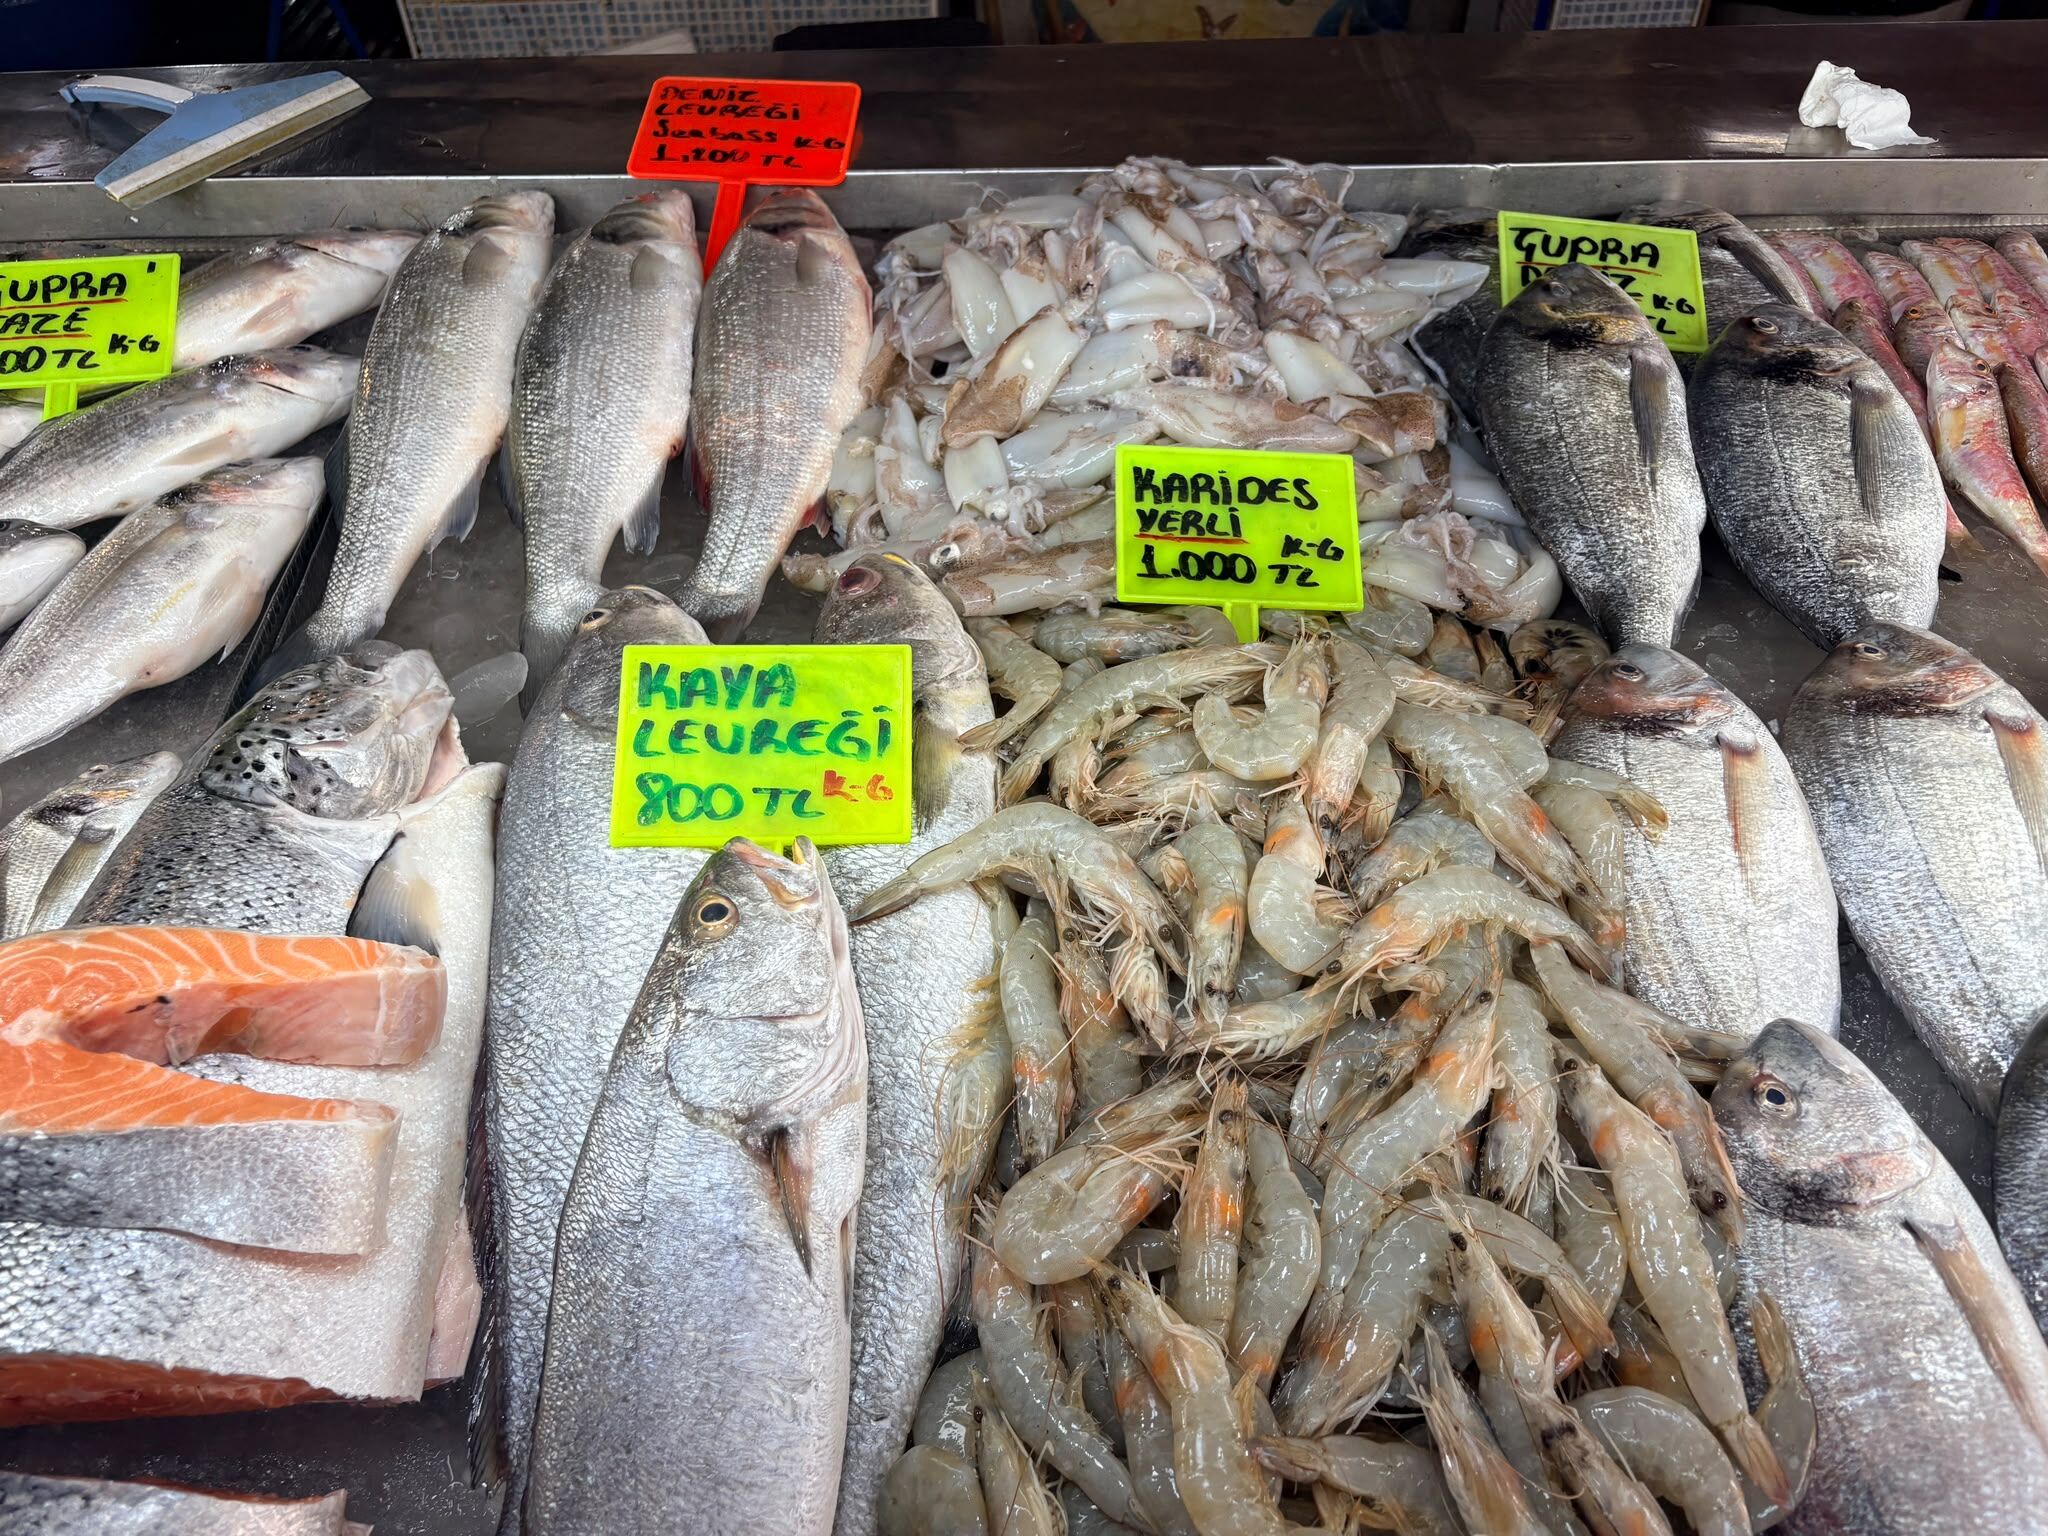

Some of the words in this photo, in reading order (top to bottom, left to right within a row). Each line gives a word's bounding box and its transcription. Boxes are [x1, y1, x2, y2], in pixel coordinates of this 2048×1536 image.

[760, 154, 803, 168] TL
[1646, 315, 1677, 335] L
[52, 350, 100, 369] TL
[1133, 466, 1319, 511] KARİDES
[1136, 507, 1242, 538] YERLİ
[1136, 544, 1257, 584] 1.000
[1267, 564, 1320, 588] TL
[637, 662, 797, 710] KAYA
[635, 772, 744, 826] 800
[752, 787, 826, 818] TL
